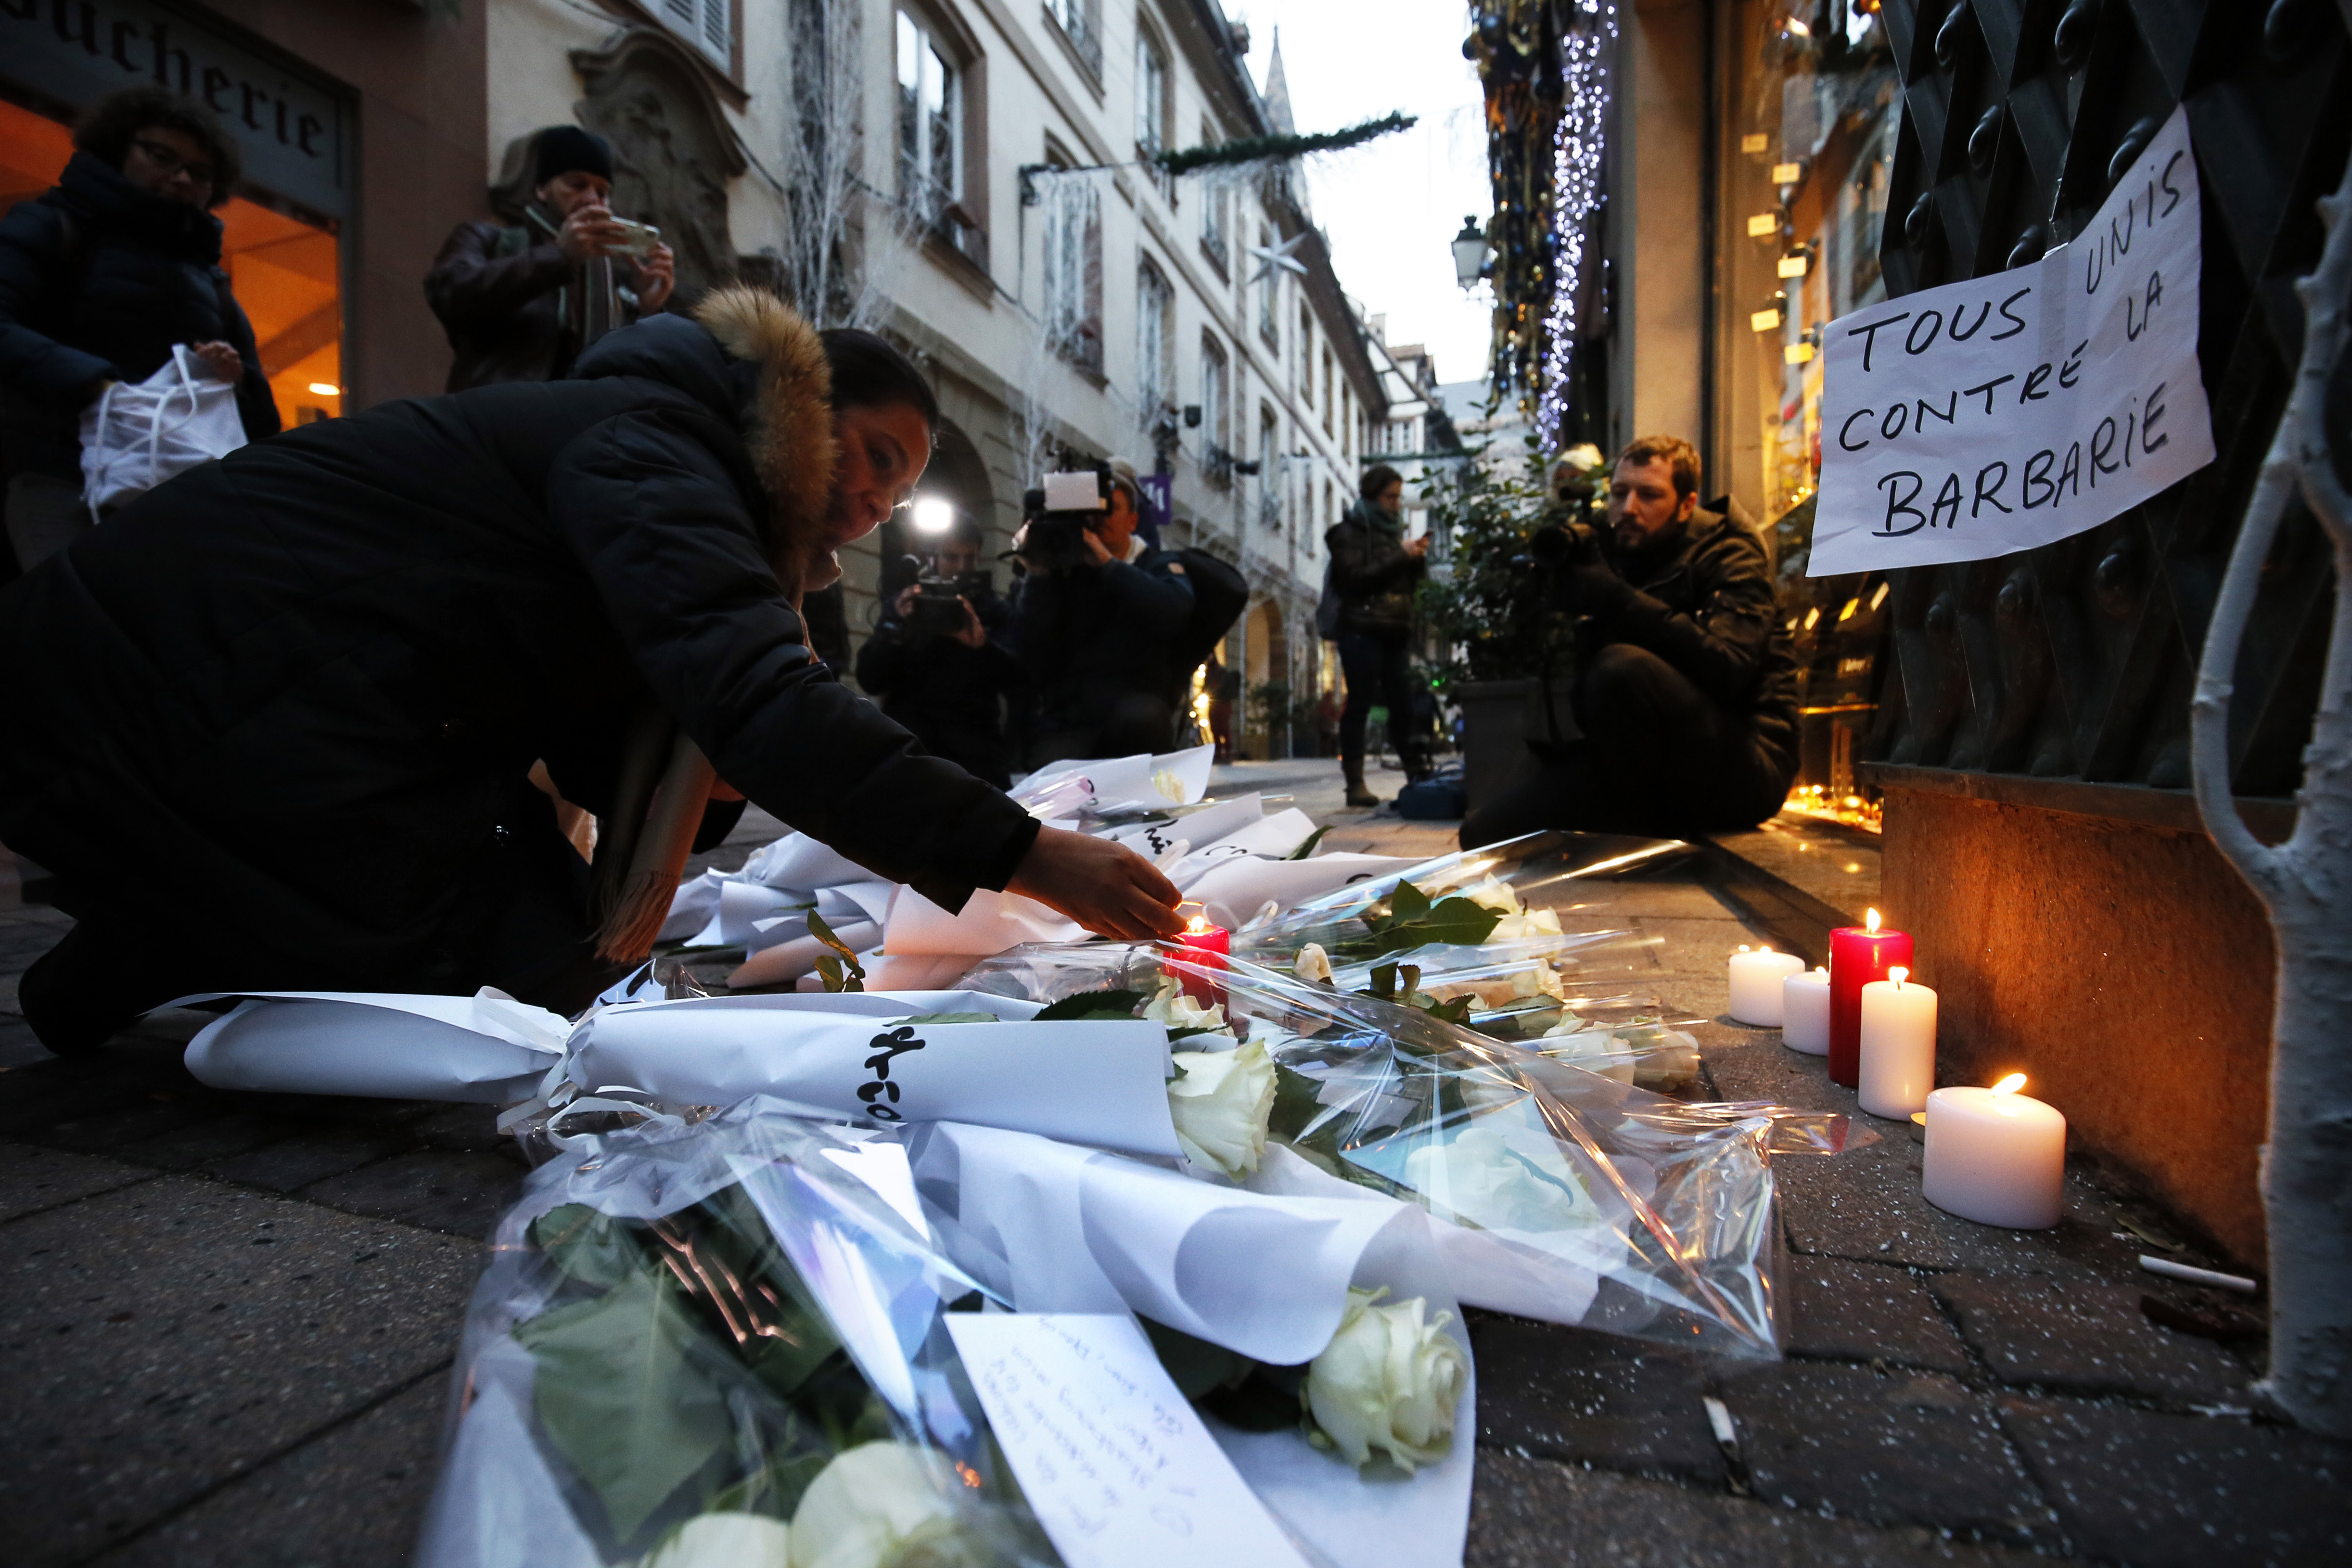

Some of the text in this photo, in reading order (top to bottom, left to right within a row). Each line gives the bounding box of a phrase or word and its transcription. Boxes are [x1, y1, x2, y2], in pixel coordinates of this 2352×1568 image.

[1848, 150, 2184, 372] TOUS UNIS
[2127, 271, 2163, 342] LA
[1872, 382, 2169, 537] BARBARIE
